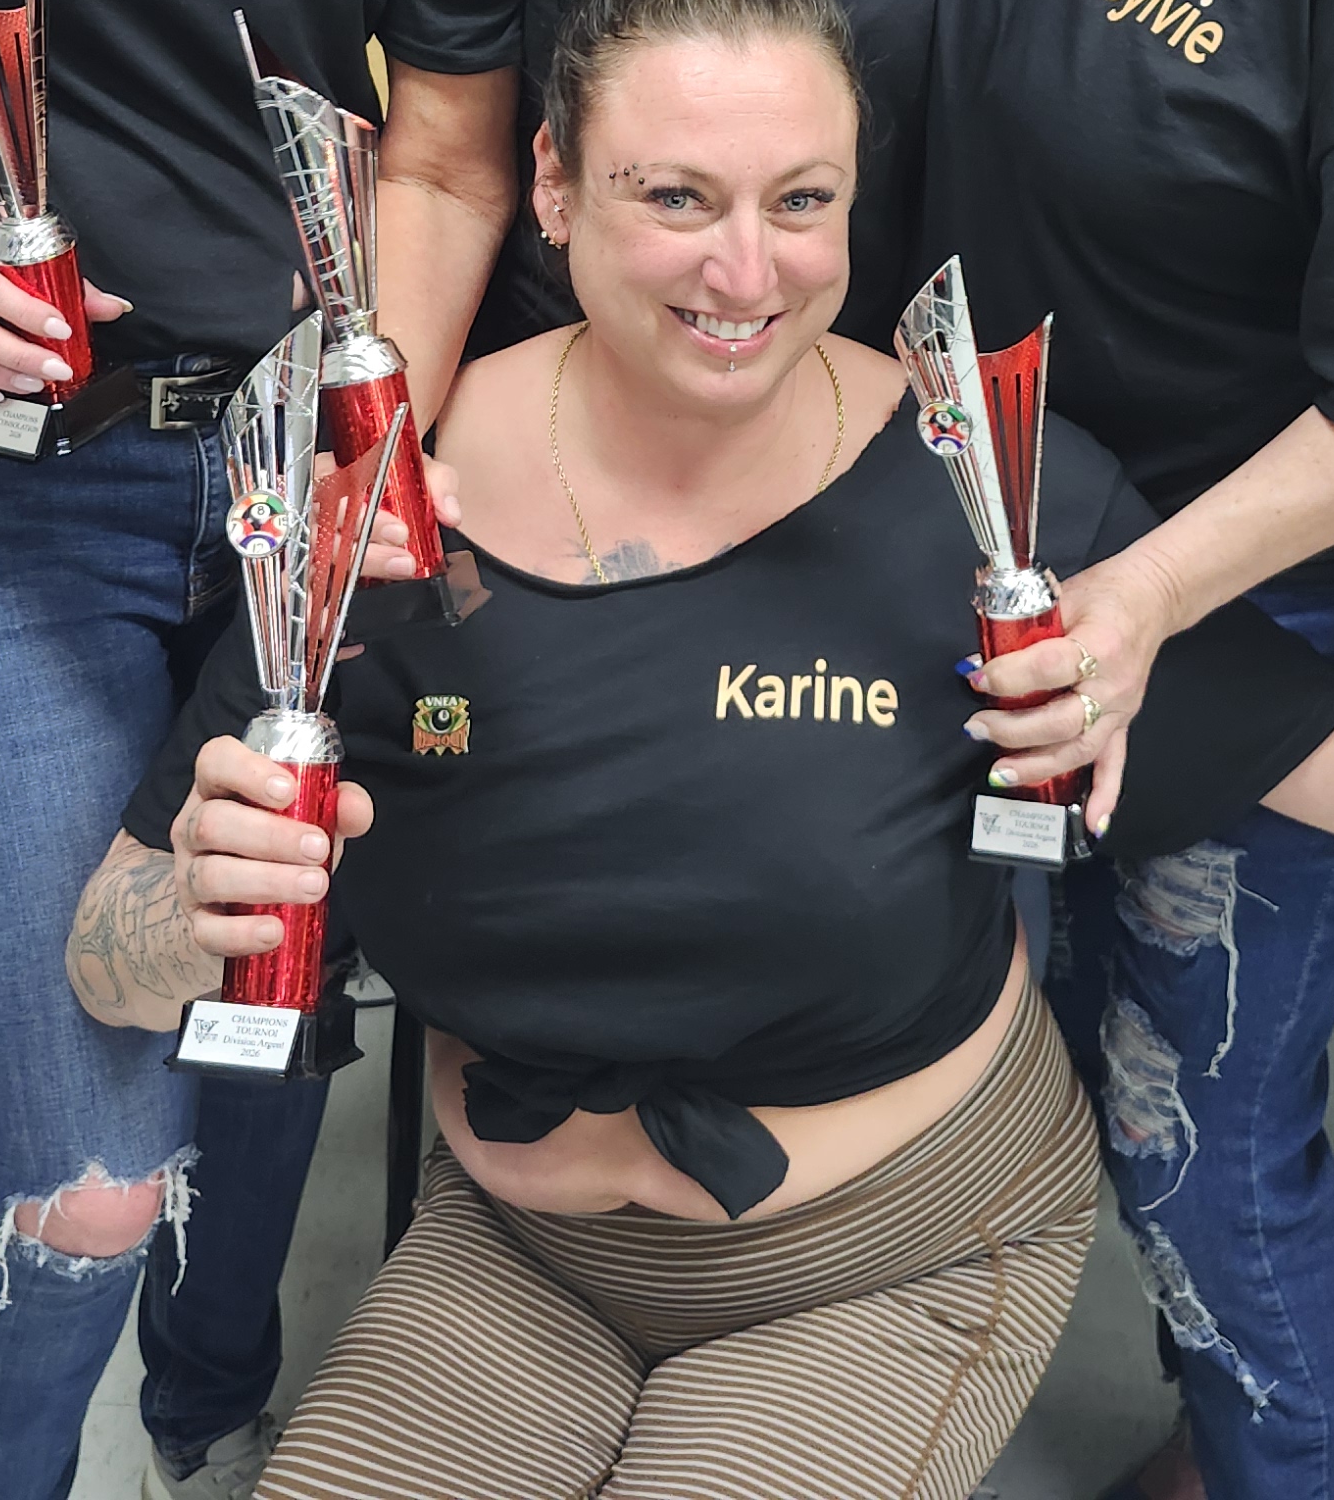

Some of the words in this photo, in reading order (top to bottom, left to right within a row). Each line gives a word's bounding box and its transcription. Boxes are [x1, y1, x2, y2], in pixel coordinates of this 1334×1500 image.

[714, 658, 899, 729] Karine
[424, 695, 458, 707] VNEA
[231, 1014, 289, 1028] CHAMPIONS
[235, 1025, 279, 1038] TOURNOI
[223, 1034, 256, 1046] Division
